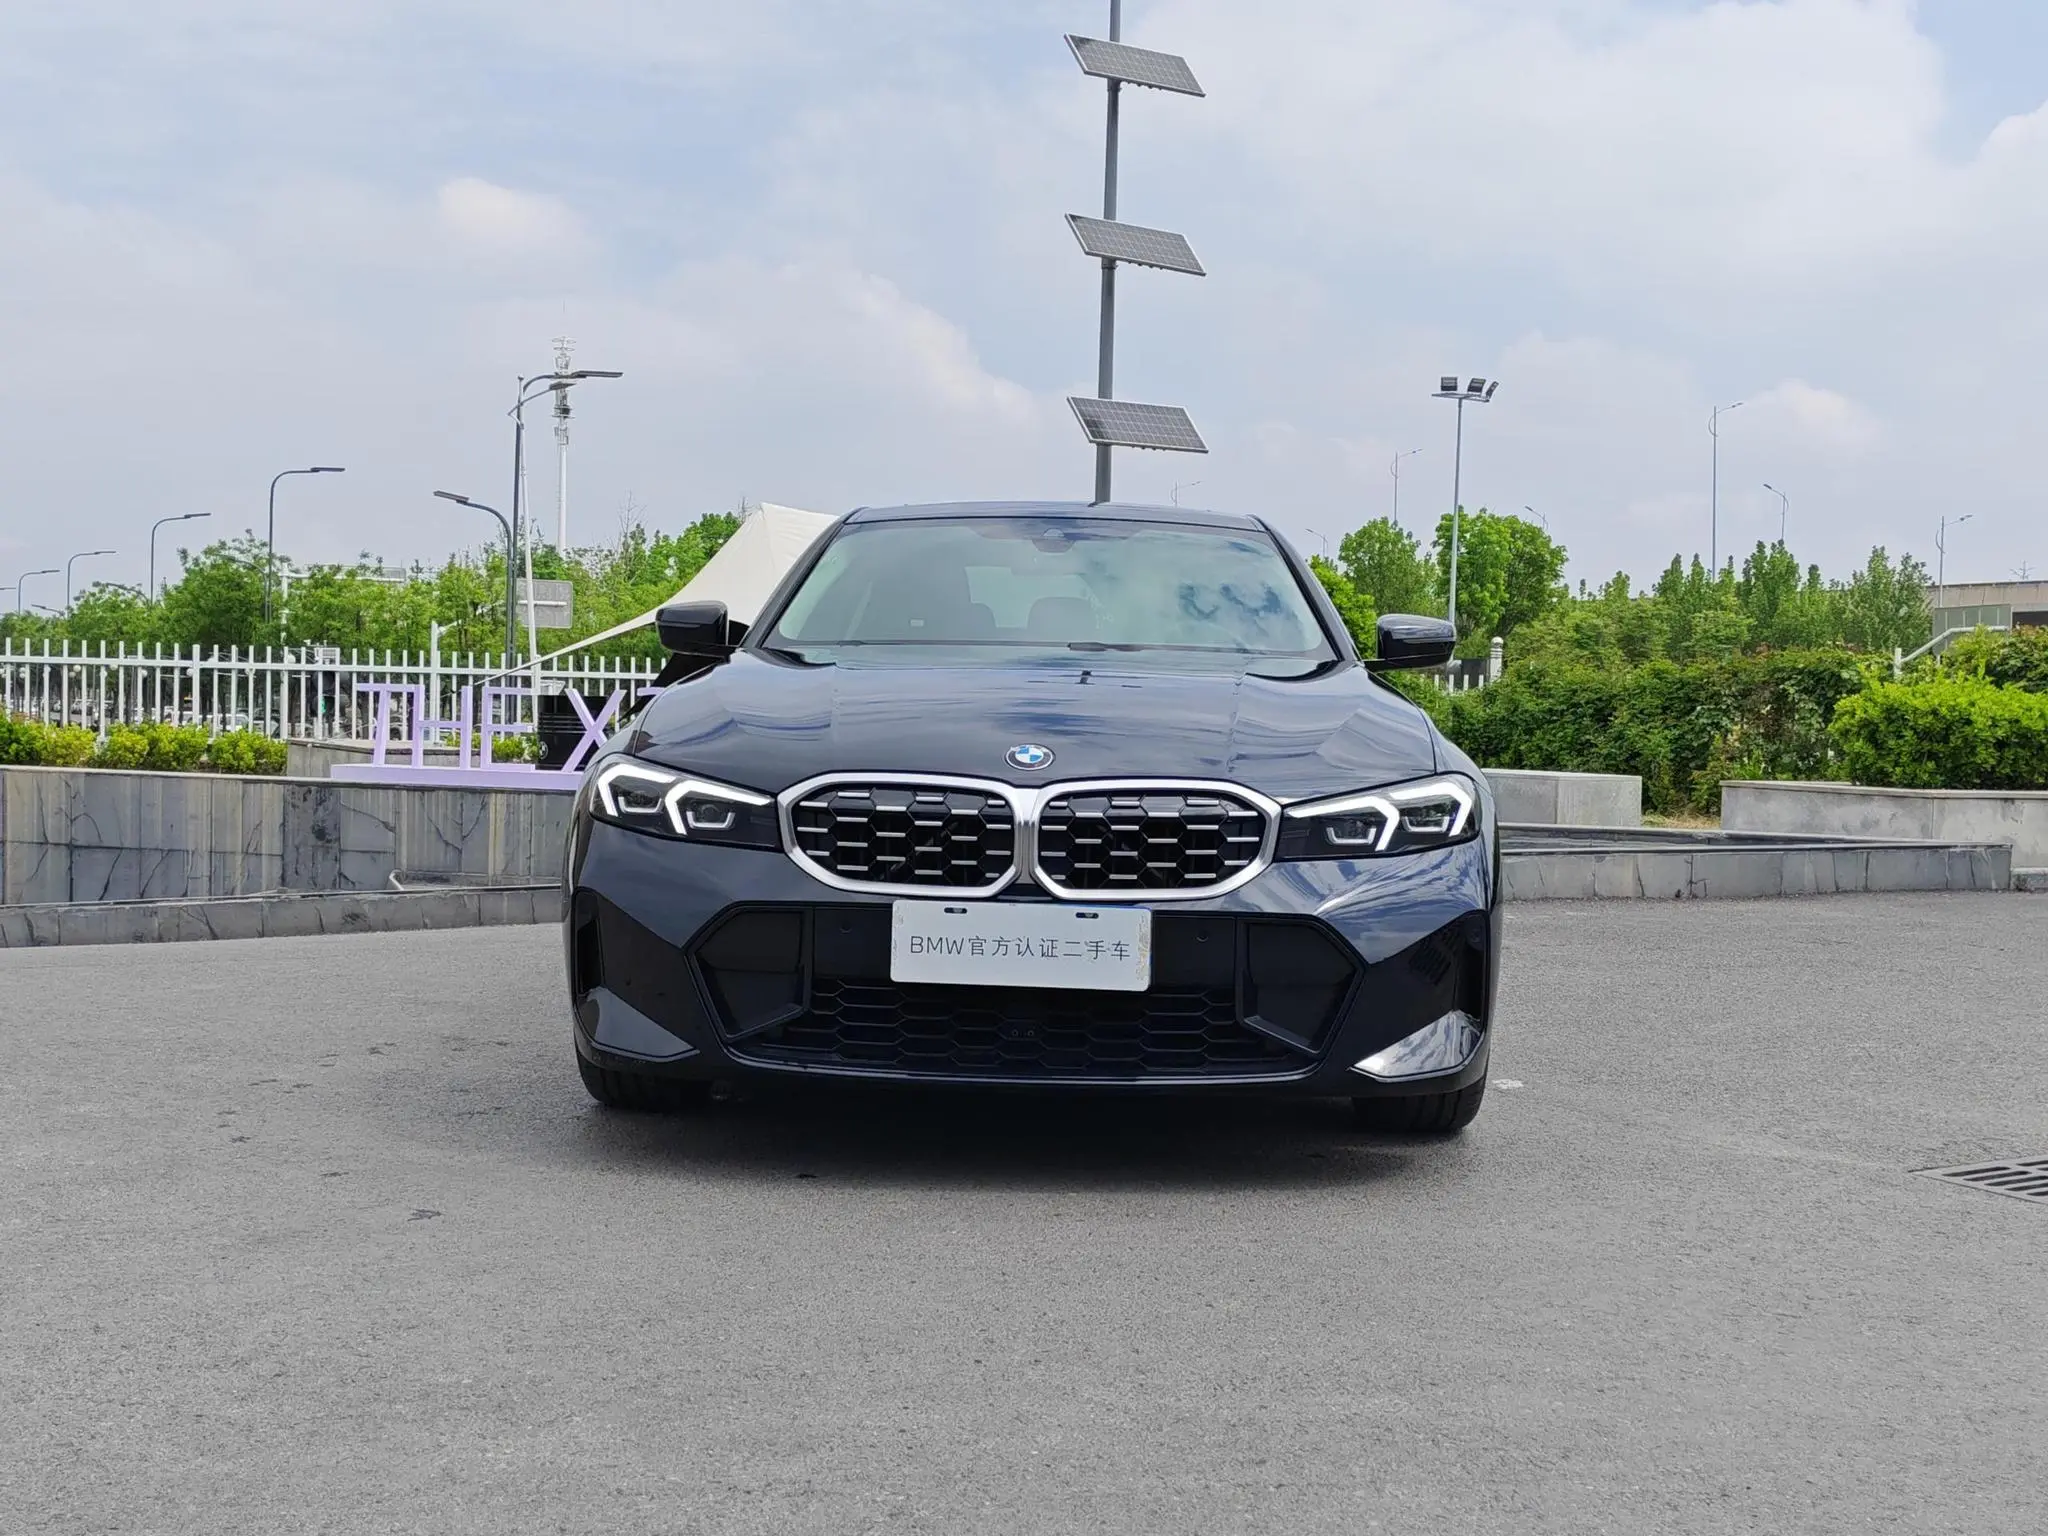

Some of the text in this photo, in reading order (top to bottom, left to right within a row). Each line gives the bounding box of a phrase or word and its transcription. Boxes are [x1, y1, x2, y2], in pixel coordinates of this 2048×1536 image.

[356, 683, 536, 772] THE
[910, 935, 1131, 961] BMW官方认证二手车
